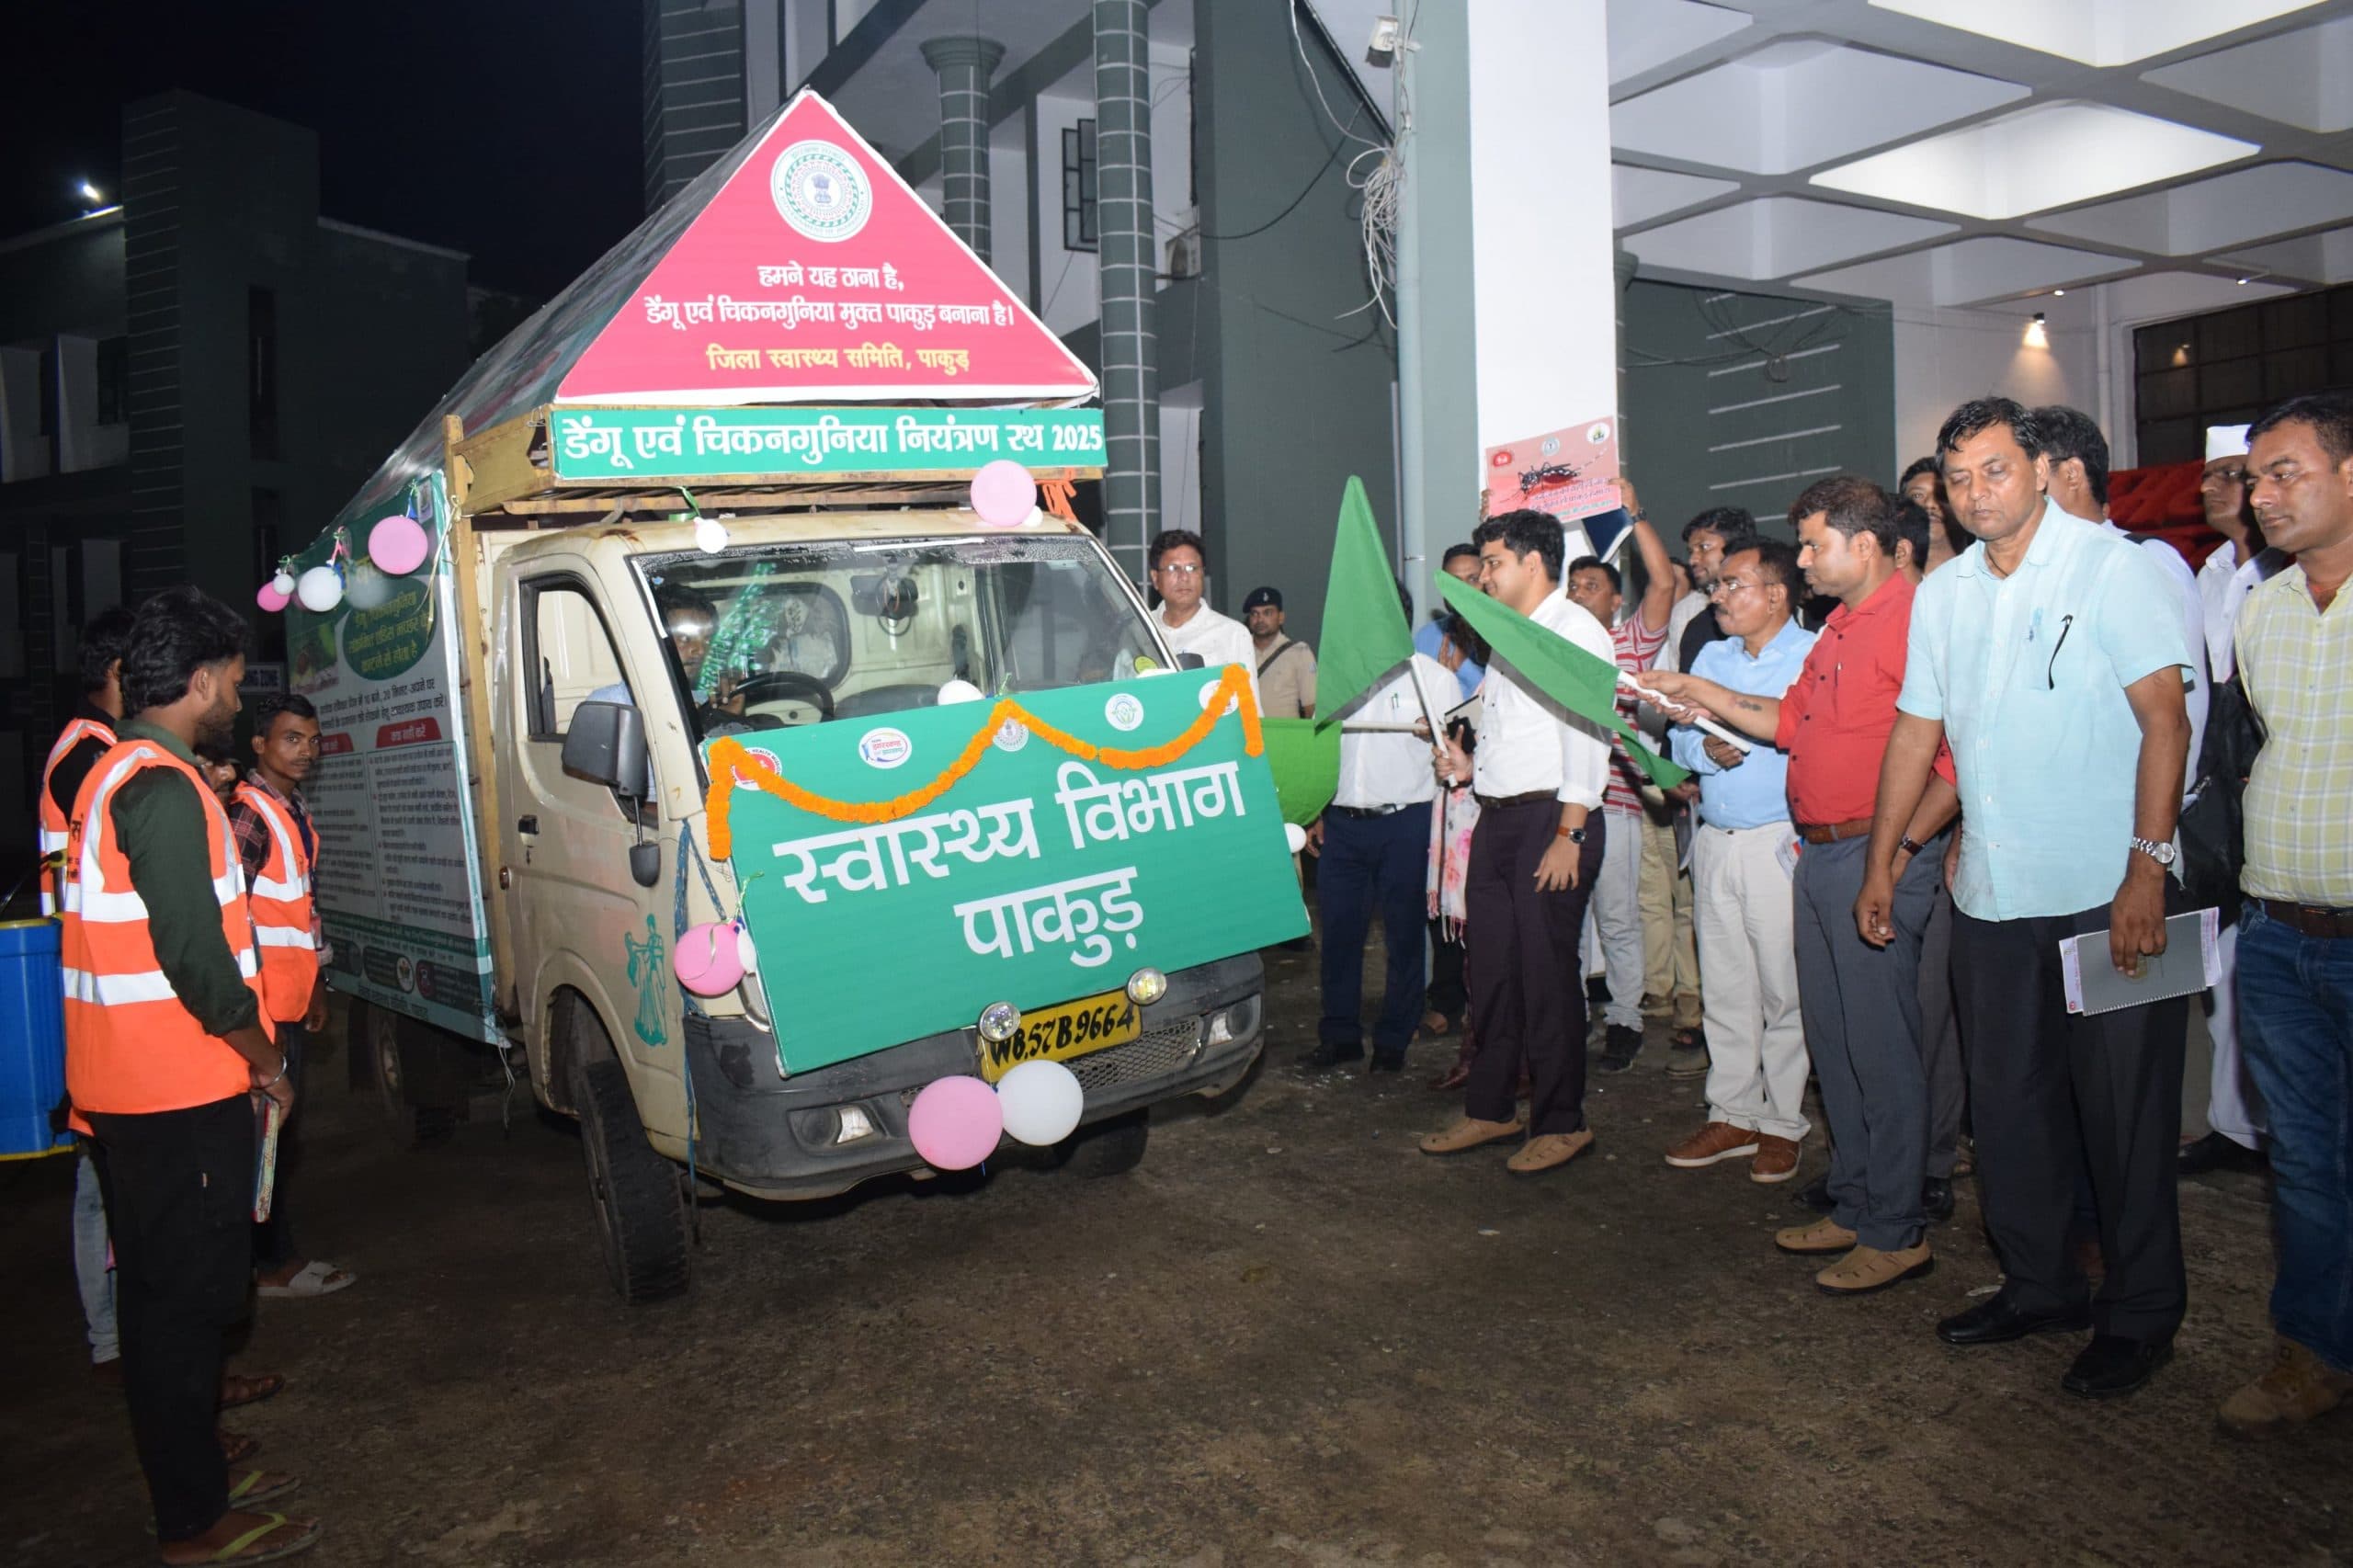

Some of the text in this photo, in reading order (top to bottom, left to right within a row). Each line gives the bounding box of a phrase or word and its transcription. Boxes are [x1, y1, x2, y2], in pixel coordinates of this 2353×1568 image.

[757, 260, 904, 290] हमने यह ठाना है,
[644, 294, 1015, 331] डेंगू एवं चिकनगुनिया मुक्त पाकुड़ बनाना है।
[706, 341, 970, 376] जिला स्वास्थ्य समिति, पाकुड़
[562, 414, 1103, 470] डेंगू एवं चिकनगुनिया नियंत्रण रथ 2025
[772, 759, 1246, 904] स्वास्थ्य विभाग
[953, 866, 1144, 968] पाकुड़
